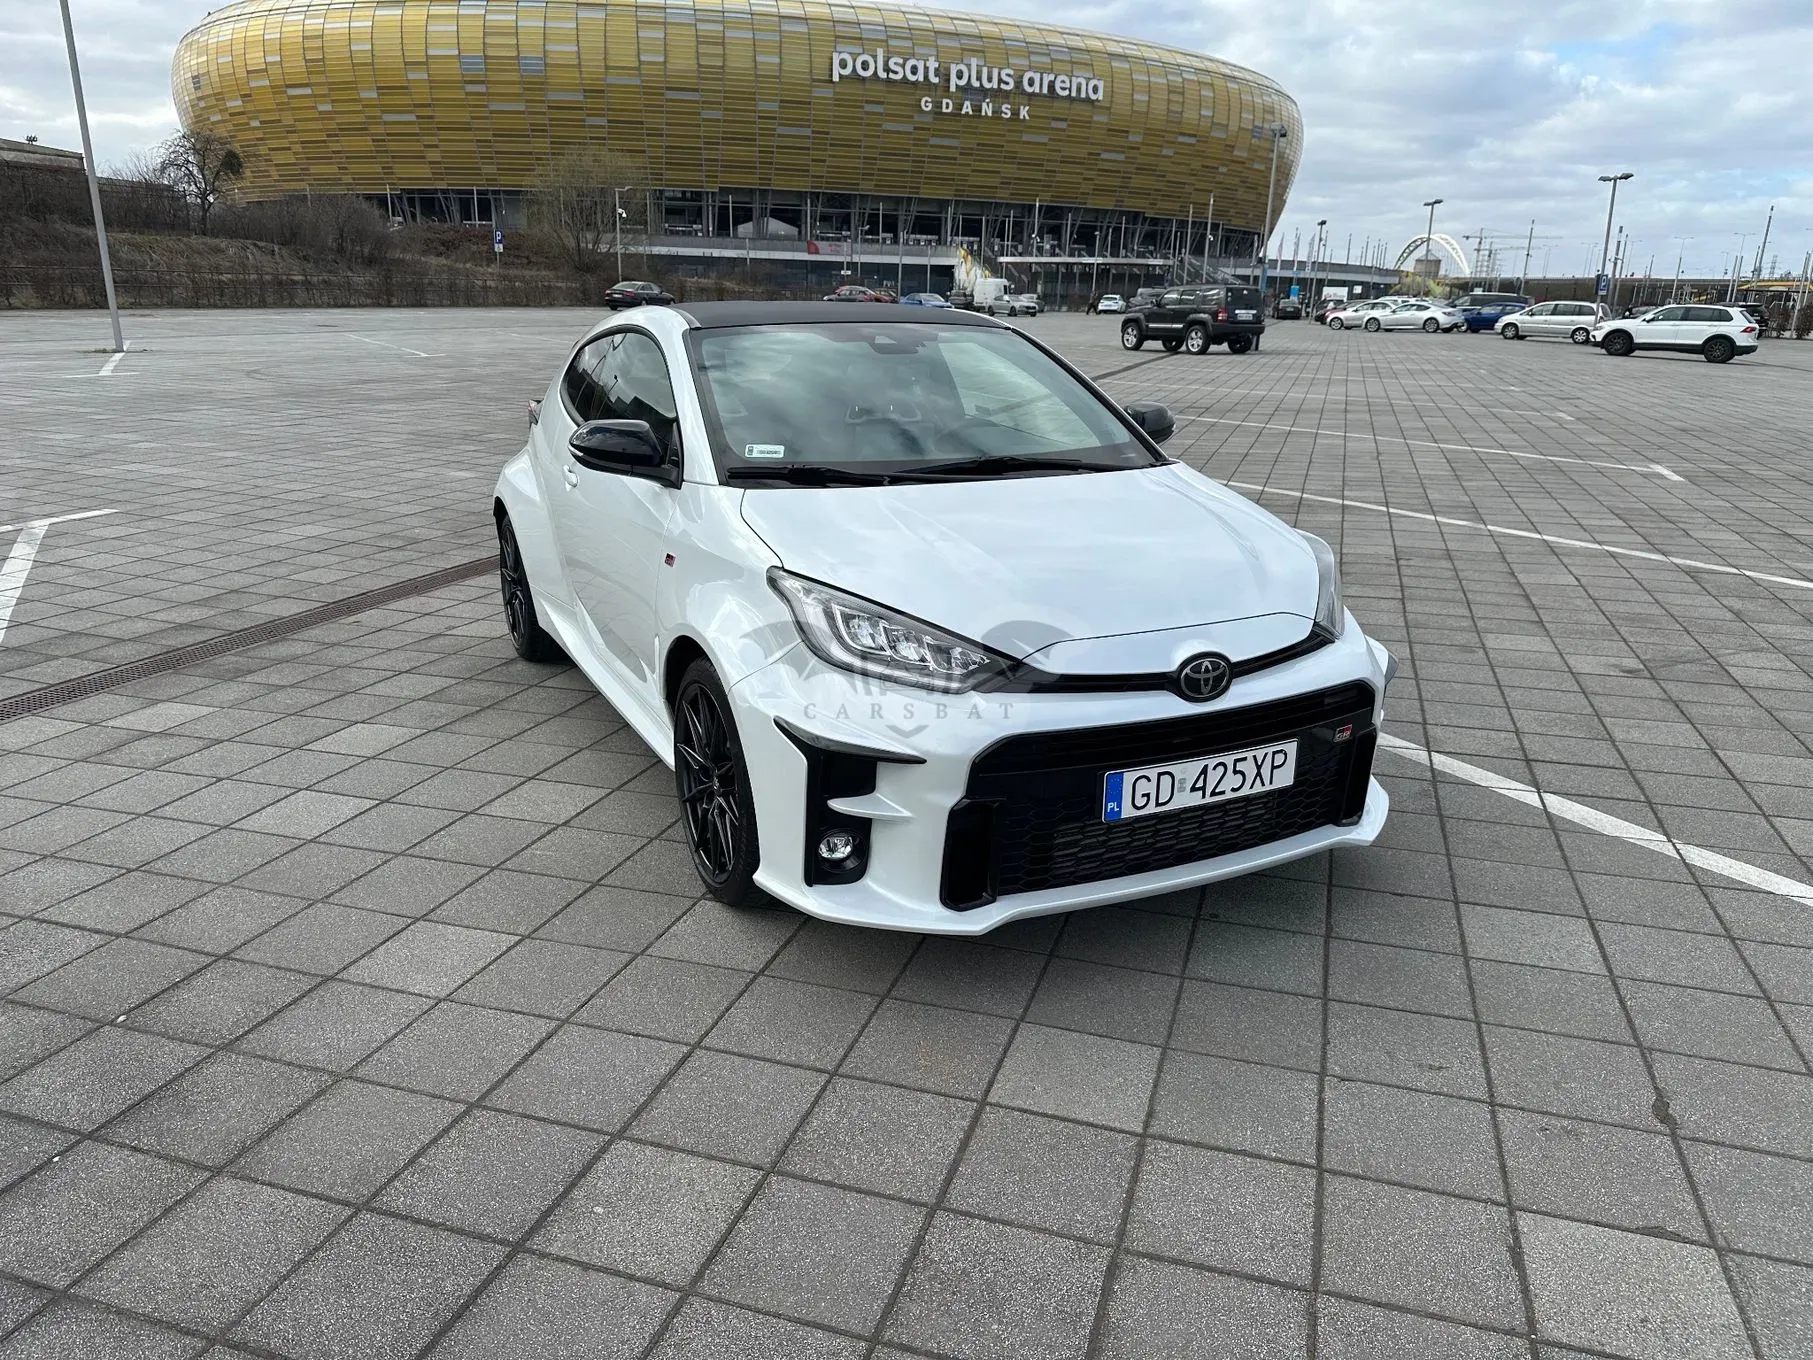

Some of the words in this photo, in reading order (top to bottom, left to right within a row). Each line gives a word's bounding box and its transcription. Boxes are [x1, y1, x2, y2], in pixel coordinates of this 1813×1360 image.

[832, 48, 940, 83] polsat
[950, 57, 1014, 92] plus
[1022, 69, 1104, 100] arena
[920, 96, 1031, 120] GDAŃSK
[496, 231, 502, 243] P
[1131, 770, 1176, 811] GD
[1189, 748, 1289, 799] 425XP
[1107, 801, 1120, 812] PL
